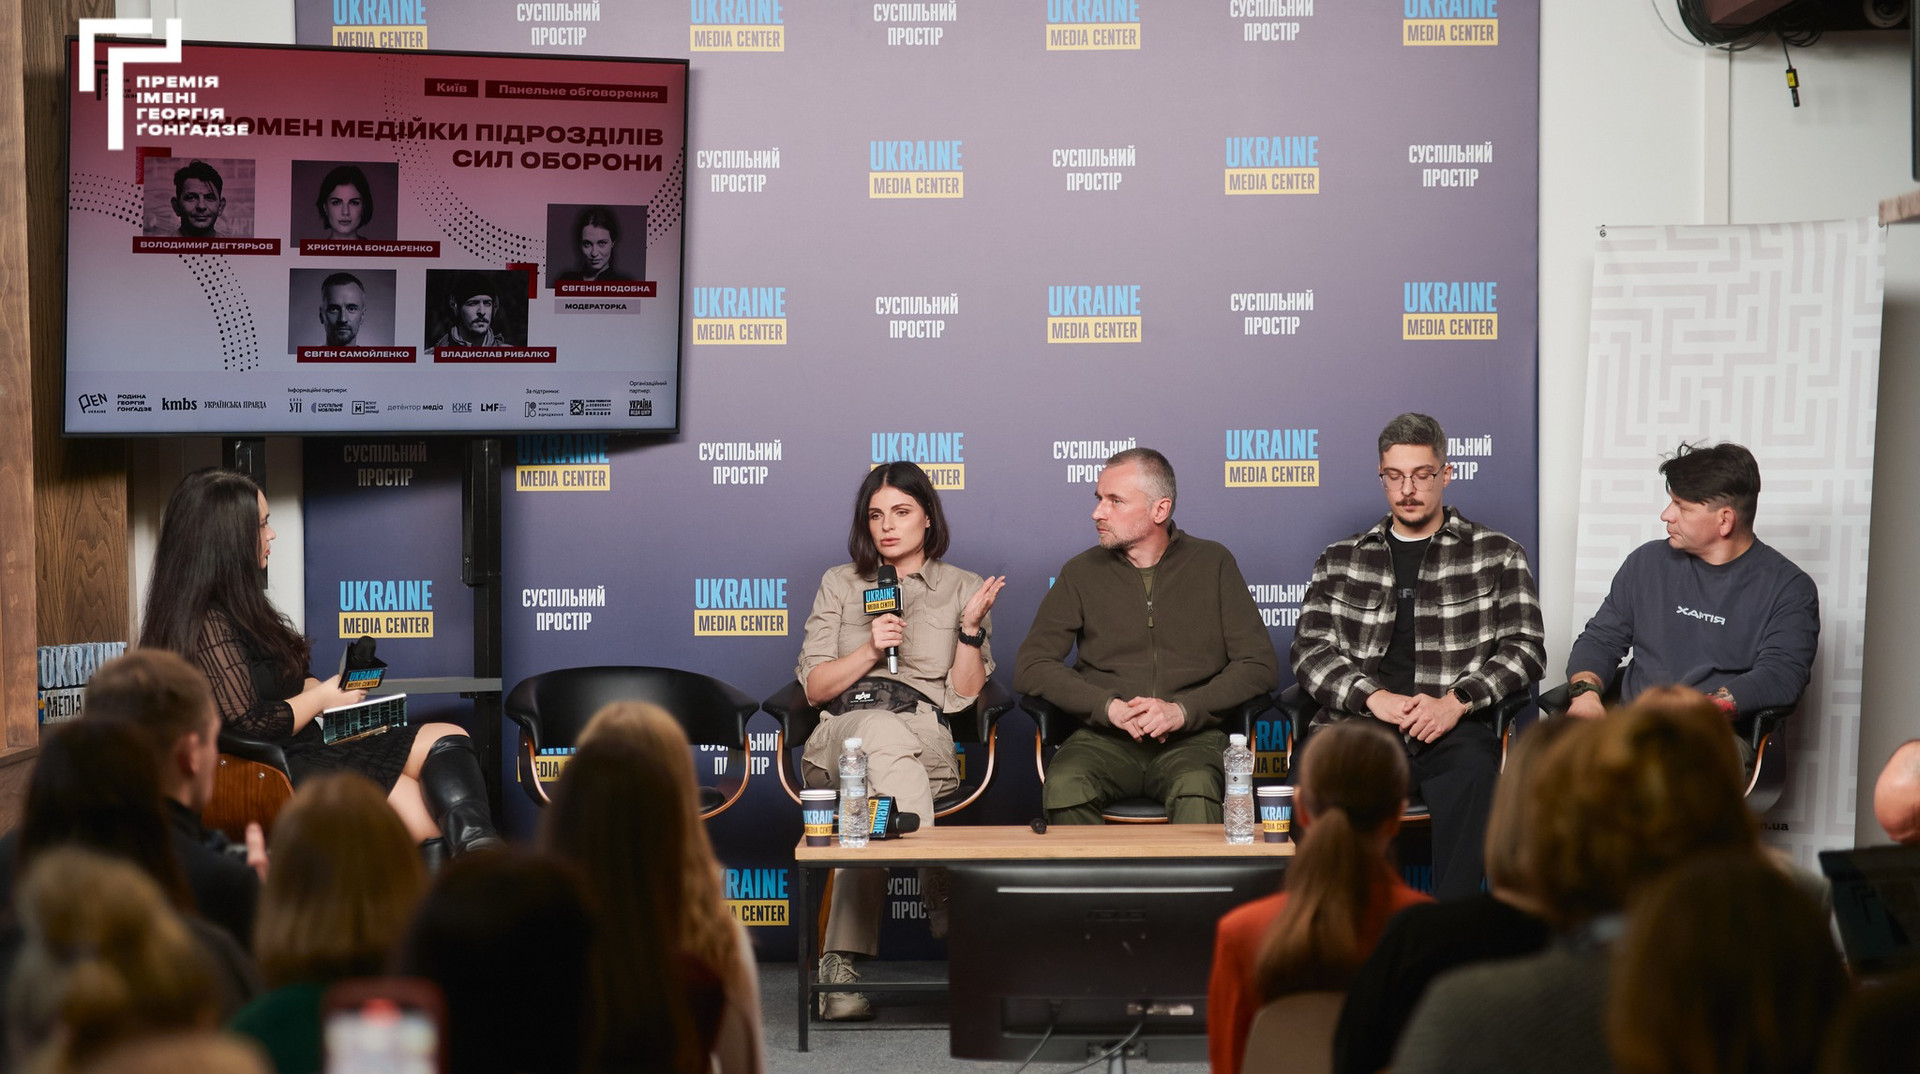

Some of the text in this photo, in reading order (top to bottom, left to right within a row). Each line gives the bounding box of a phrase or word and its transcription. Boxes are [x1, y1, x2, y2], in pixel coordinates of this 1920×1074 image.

[334, 0, 426, 24] UKRAINE
[517, 0, 600, 21] СУСПІЛЬНИЙ
[691, 0, 782, 24] UKRAINE
[1048, 0, 1140, 22] UKRAINE
[1404, 0, 1498, 18] UKRAINE
[337, 30, 423, 47] MEDIA CENTER
[530, 27, 586, 45] ПРОСТІР
[694, 30, 780, 48] MEDIA CENTER
[887, 27, 943, 45] ПРОСТІР
[1051, 28, 1137, 46] MEDIA CENTER
[1243, 23, 1299, 41] ПРОСТІР
[1407, 24, 1493, 42] MEDIA CENTER
[436, 82, 659, 99] Київ Панельне обговорення
[331, 116, 468, 141] МЕДІЙКИ
[475, 123, 664, 146] ПІДРОЗДІЛІВ
[698, 147, 780, 168] СУСПІЛЬНИЙ
[870, 141, 962, 170] UKRAINE
[1053, 145, 1135, 167] СУСПІЛЬНИЙ
[1226, 136, 1318, 166] UKRAINE
[1409, 142, 1492, 163] СУСПІЛЬНИЙ
[452, 150, 663, 171] СИЛ ОБОРОНИ
[711, 174, 767, 192] ПРОСТІР
[873, 176, 959, 194] MEDIA CENTER
[1066, 173, 1122, 191] ПРОСТІР
[1229, 172, 1315, 190] MEDIA CENTER
[1422, 169, 1478, 187] ПРОСТІР
[140, 241, 273, 250] ВОЛОДИМИР ДЕГТЯРЬОВ
[307, 243, 433, 253] ХРИСТИНА БОНДАРЕНКО
[562, 284, 650, 293] ЄВГЕНІЯ ПОДОБНА
[1405, 282, 1497, 312] UKRAINE
[565, 303, 627, 311] МОДЕРАТОРКА
[694, 288, 785, 317] UKRAINE
[876, 293, 958, 314] СУСПІЛЬНИЙ
[1049, 286, 1140, 316] UKRAINE
[1231, 289, 1313, 311] СУСПІЛЬНИЙ
[697, 323, 783, 341] MEDIA CENTER
[889, 320, 945, 338] ПРОСТІР
[1052, 322, 1138, 340] MEDIA CENTER
[1244, 317, 1300, 335] ПРОСТІР
[1408, 318, 1494, 336] MEDIA CENTER
[304, 348, 410, 359] ЄВГЕН САМОЙЛЕНКО
[441, 350, 550, 359] ВЛАДИСЛАВ РИБАЛКО
[78, 393, 108, 414] PEN
[161, 397, 198, 411] kmbs
[204, 400, 267, 409] УКРАЇНСЬКА ПРАВДА
[481, 403, 499, 412] LMF
[344, 441, 427, 462] СУСПІЛЬНИЙ
[517, 433, 609, 464] UKRAINE
[699, 440, 782, 461] СУСПІЛЬНИЙ
[872, 432, 963, 462] UKRAINE
[1226, 429, 1318, 459] UKRAINE
[1446, 434, 1492, 456] ЛЬНИЙ
[357, 468, 413, 486] ПРОСТІР
[520, 470, 606, 488] MEDIA CENTER
[712, 467, 768, 485] ПРОСТІР
[1067, 465, 1106, 482] ПРОС
[1229, 465, 1315, 483] MEDIA CENTER
[1447, 461, 1478, 480] СТІР
[340, 581, 432, 610] UKRAINE
[523, 585, 605, 607] СУСПІЛЬНИЙ
[696, 579, 787, 609] UKRAINE
[866, 587, 895, 602] UKRAINE
[343, 616, 429, 634] MEDIA CENTER
[536, 613, 592, 631] ПРОСТІР
[699, 615, 785, 633] MEDIA CENTER
[1258, 608, 1300, 626] ОСТІР
[349, 669, 383, 681] UKRAINE
[47, 694, 82, 718] MEDIA
[873, 800, 890, 834] UKRAINE
[742, 905, 785, 921] CENTER
[892, 901, 928, 919] ПРОС
